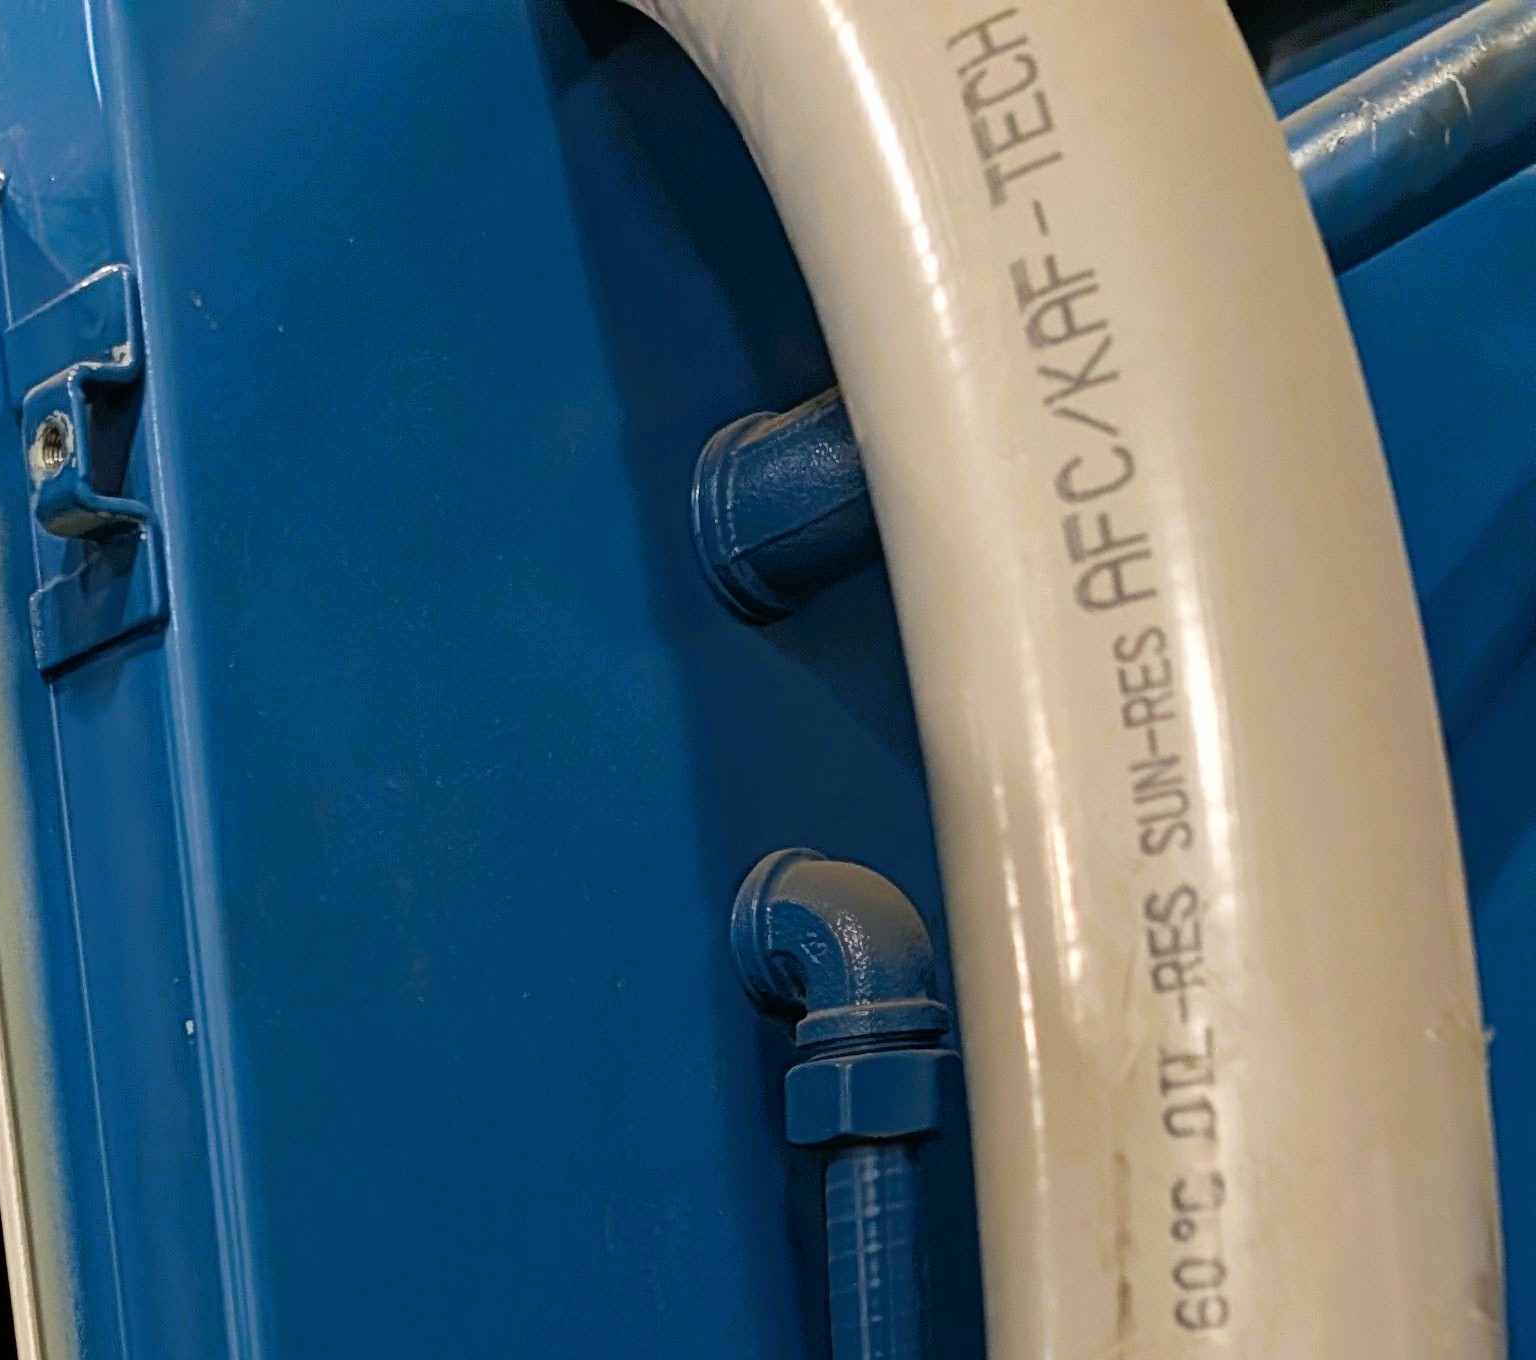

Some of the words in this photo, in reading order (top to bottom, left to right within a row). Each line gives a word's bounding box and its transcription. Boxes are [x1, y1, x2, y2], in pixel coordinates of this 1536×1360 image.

[1117, 624, 1195, 856] SUN-RES
[1144, 883, 1219, 1141] OIL-RES
[1170, 1174, 1230, 1334] 60°C
